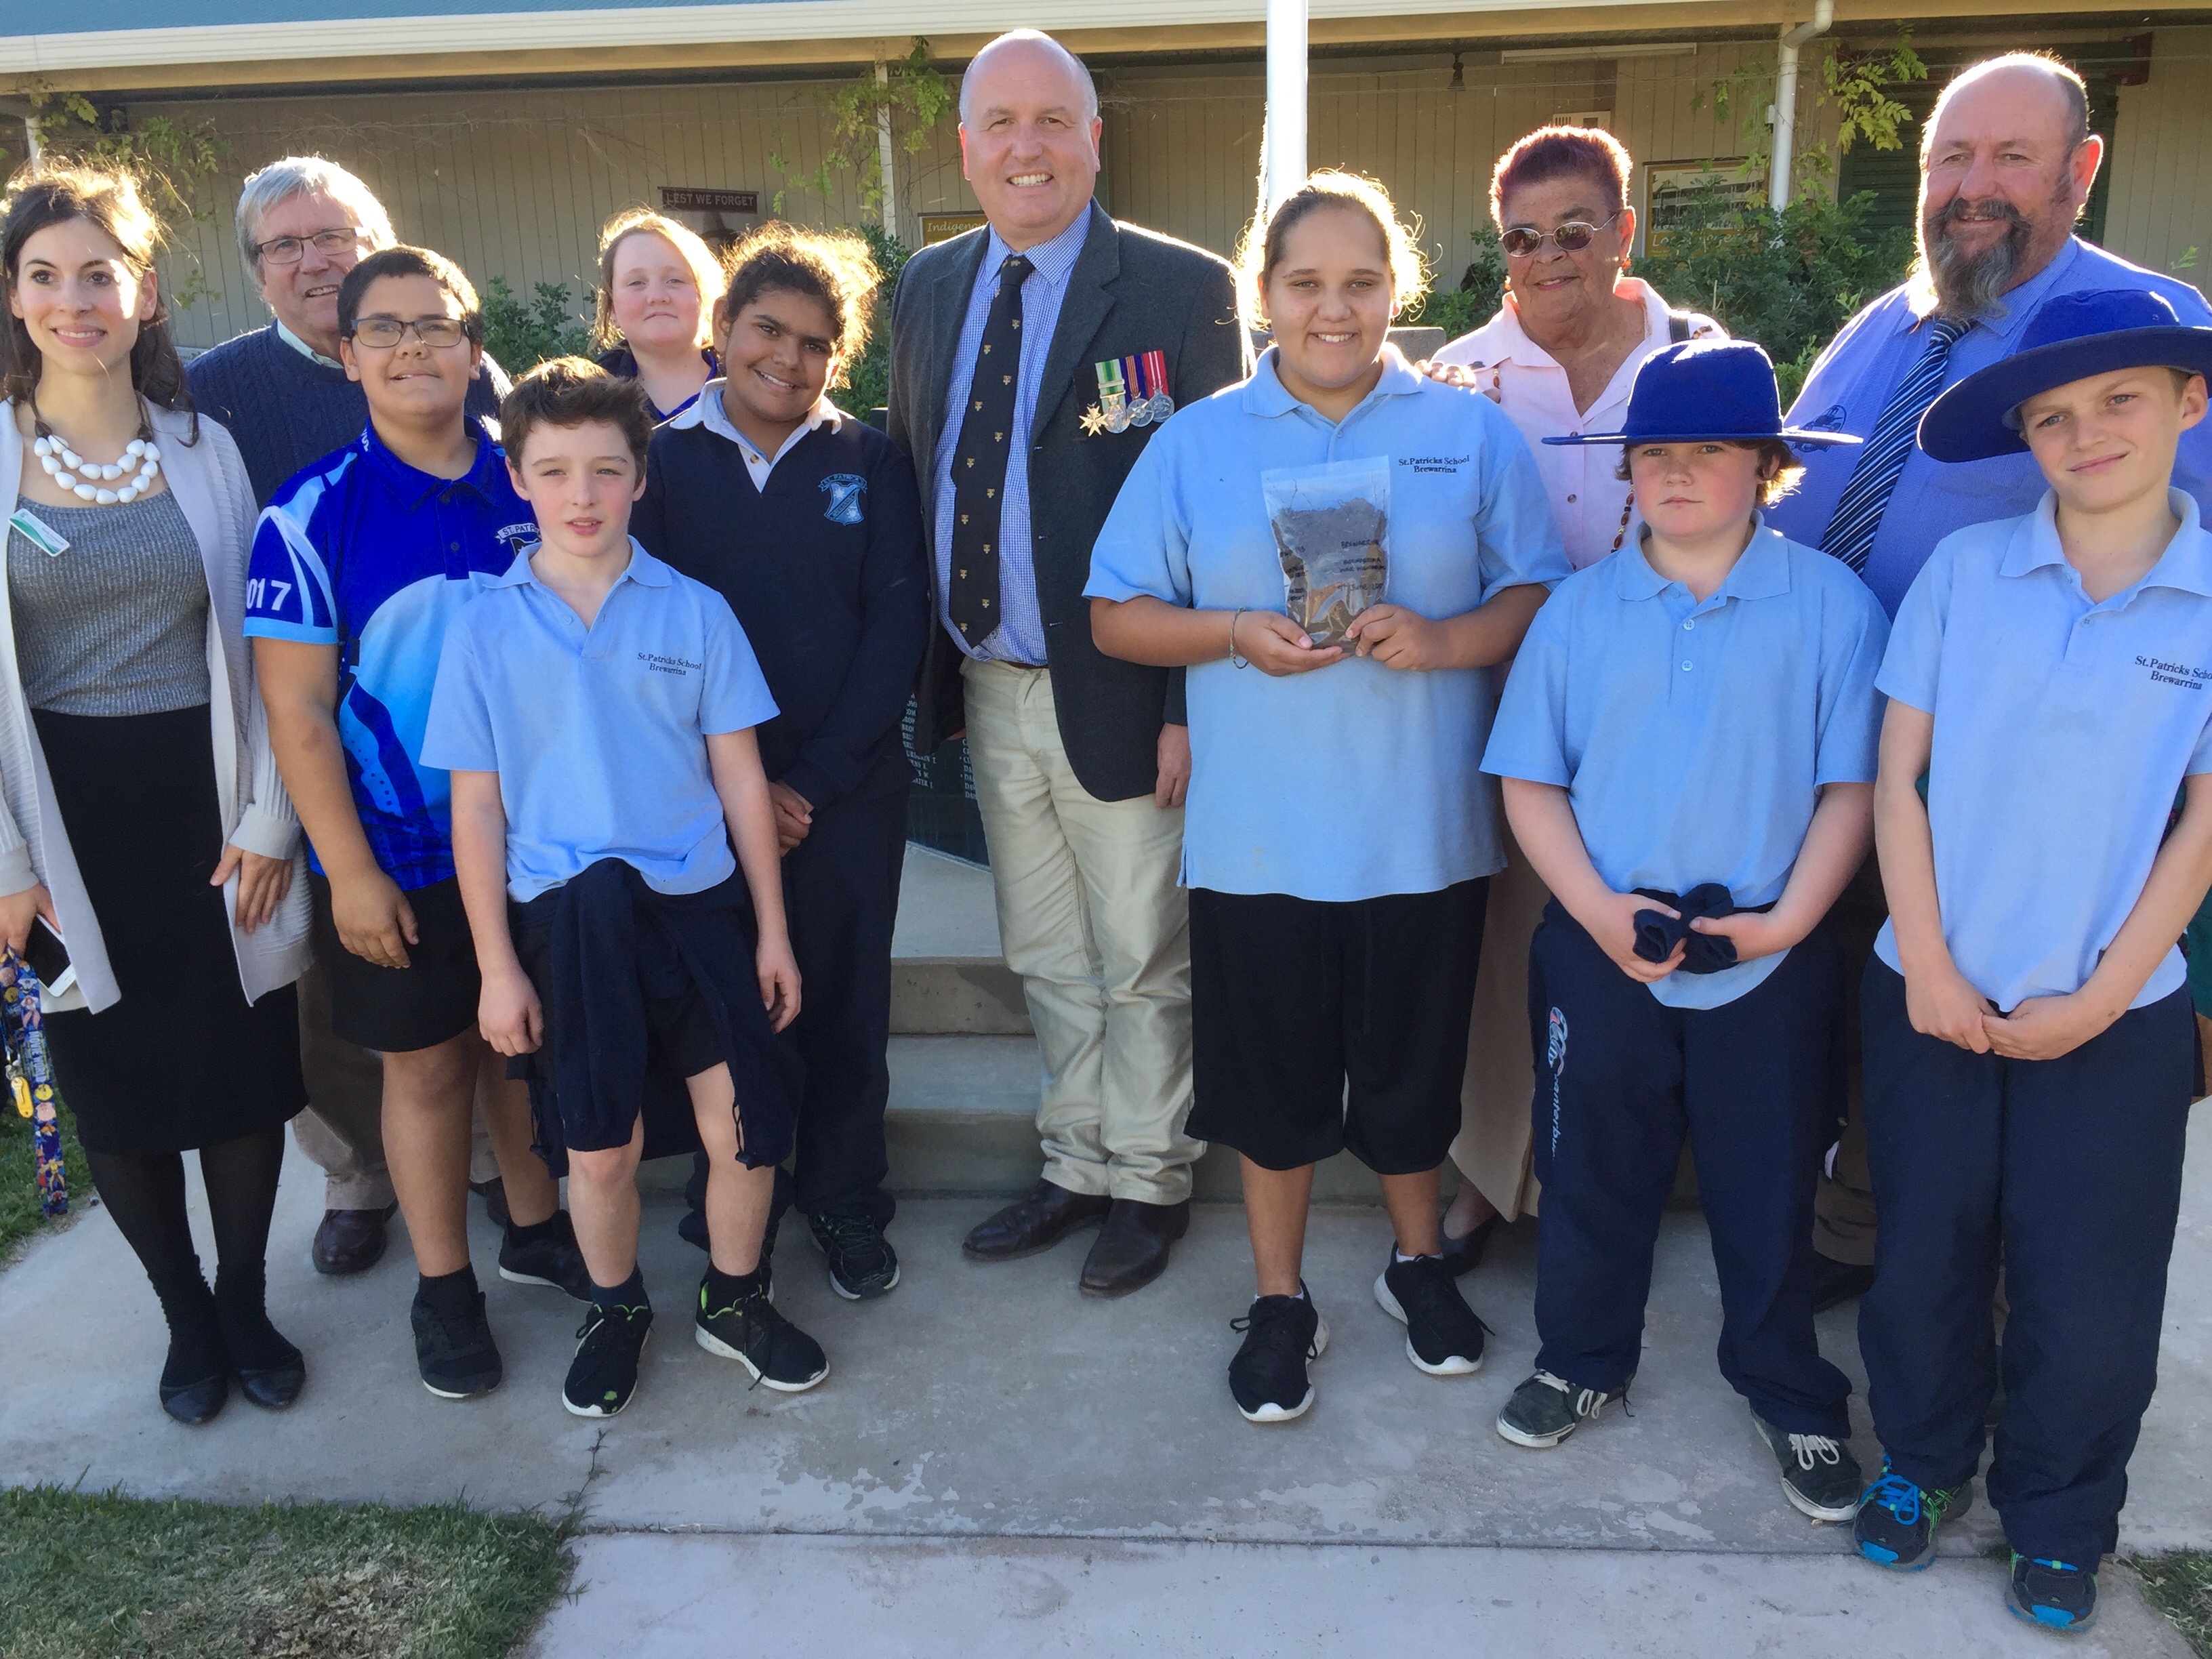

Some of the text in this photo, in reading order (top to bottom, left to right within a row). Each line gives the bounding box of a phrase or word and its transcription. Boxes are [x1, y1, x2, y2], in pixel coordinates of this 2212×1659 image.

[666, 192, 754, 207] LEST WE FORGET
[1444, 454, 1470, 465] School
[1414, 465, 1457, 473] Brewarrina
[246, 577, 291, 611] 017
[649, 663, 687, 676] Brewarrina
[676, 658, 702, 670] School
[2150, 670, 2203, 690] Brewarrina
